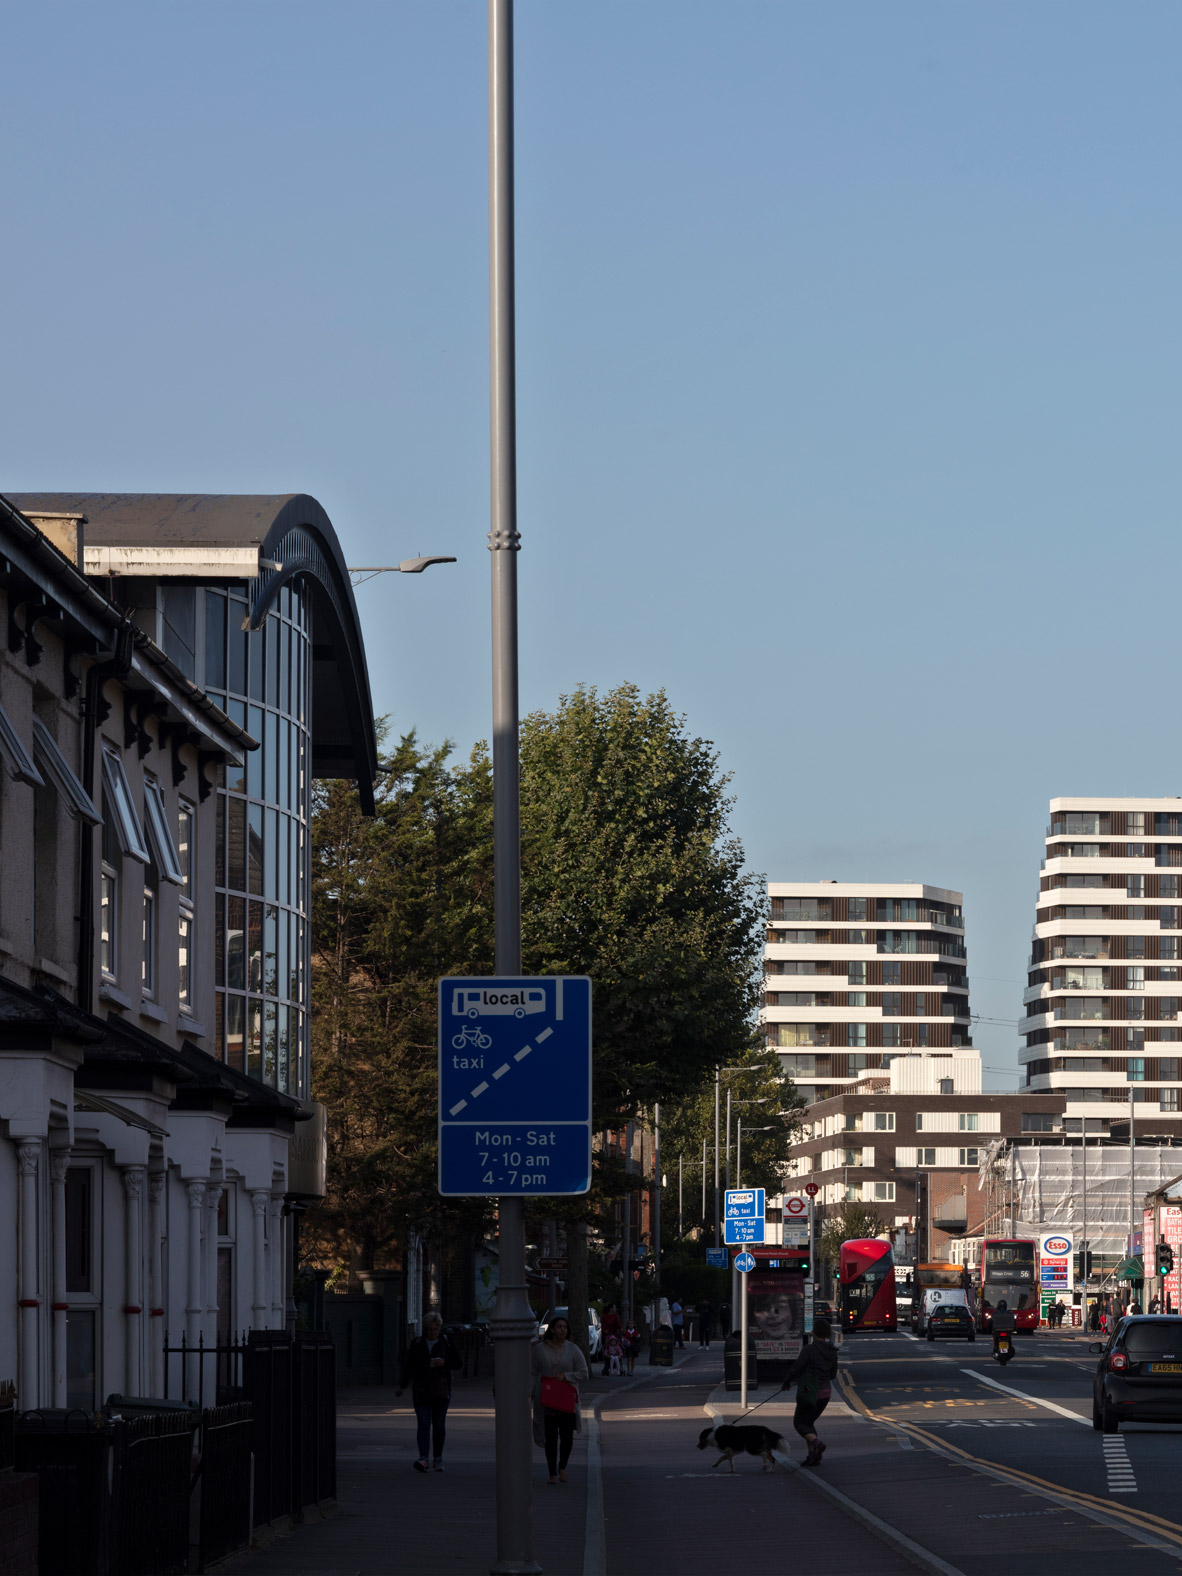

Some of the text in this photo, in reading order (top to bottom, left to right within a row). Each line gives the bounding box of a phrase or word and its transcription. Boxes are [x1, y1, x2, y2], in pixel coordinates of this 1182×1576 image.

[482, 990, 527, 1006] local
[452, 1054, 485, 1069] taxi
[475, 1131, 512, 1146] Mon
[526, 1131, 556, 1146] Sat
[478, 1152, 489, 1167] 7
[502, 1152, 521, 1167] 10
[525, 1155, 550, 1167] am
[482, 1171, 495, 1185] 4
[507, 1171, 518, 1185] 7
[521, 1173, 547, 1187] pm
[1048, 1241, 1067, 1250] Esso
[1020, 1270, 1029, 1278] 56
